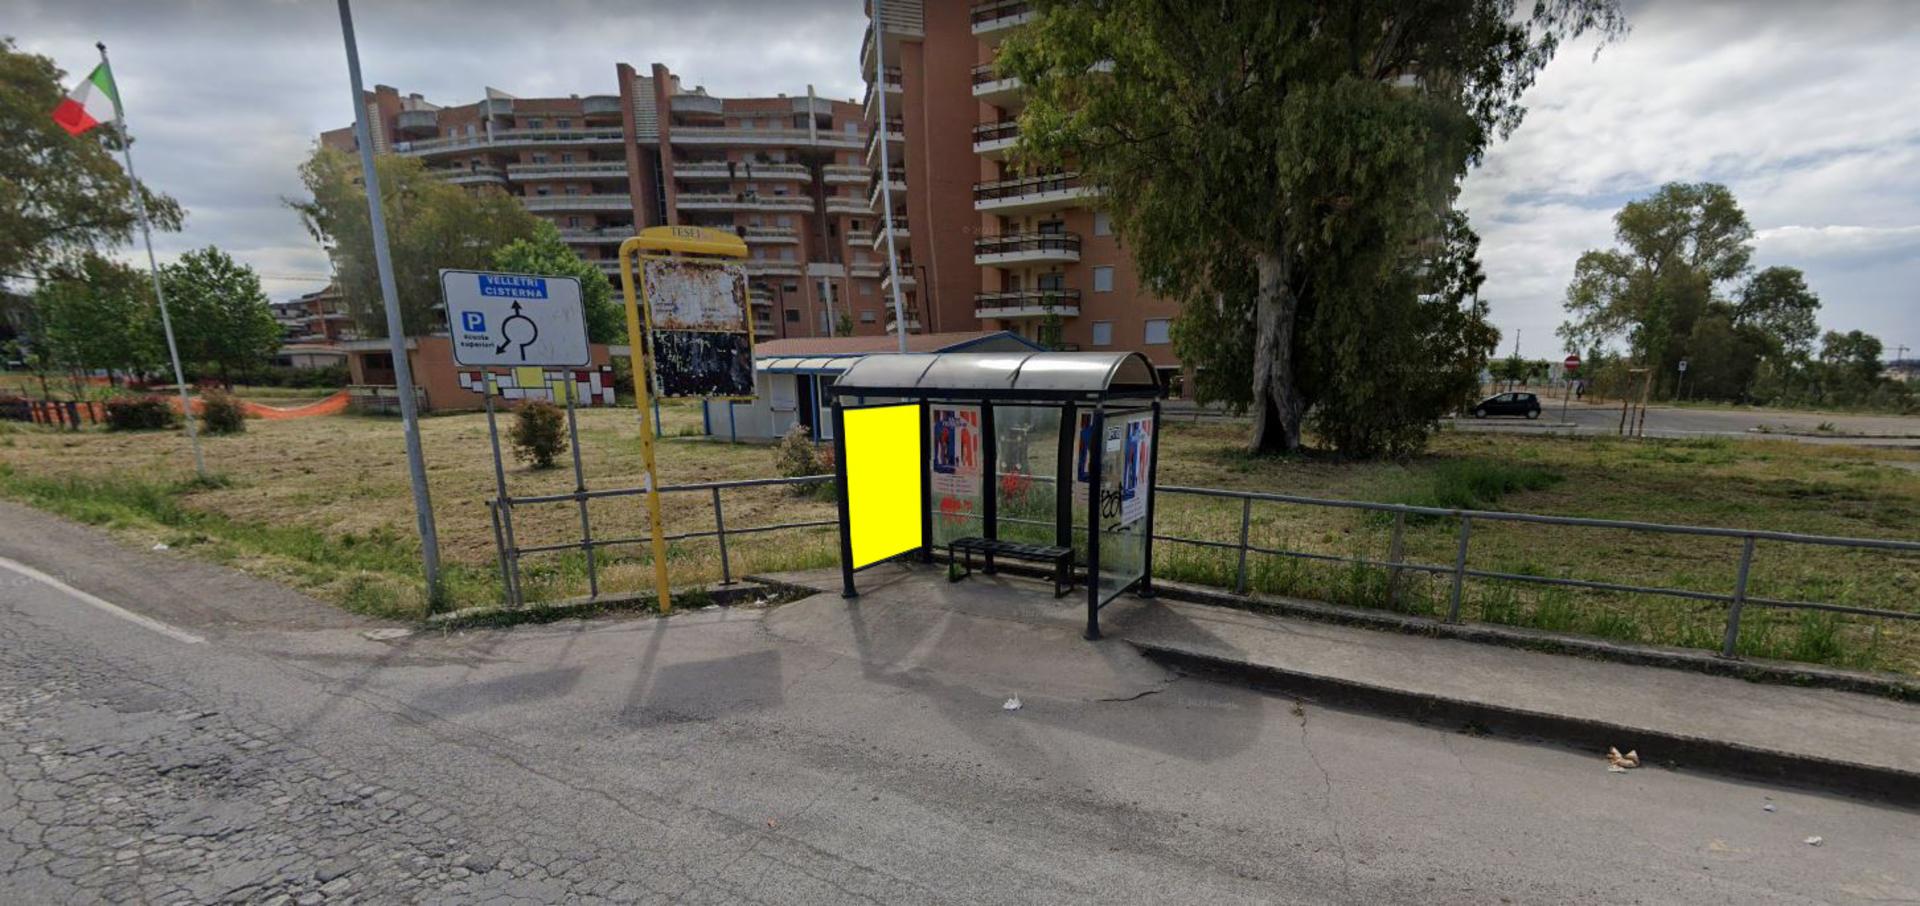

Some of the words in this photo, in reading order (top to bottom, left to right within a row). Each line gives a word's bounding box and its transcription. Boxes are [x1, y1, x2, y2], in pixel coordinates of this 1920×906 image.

[487, 276, 538, 287] VELLETRI
[485, 287, 543, 298] CISTERNA
[467, 313, 482, 330] P
